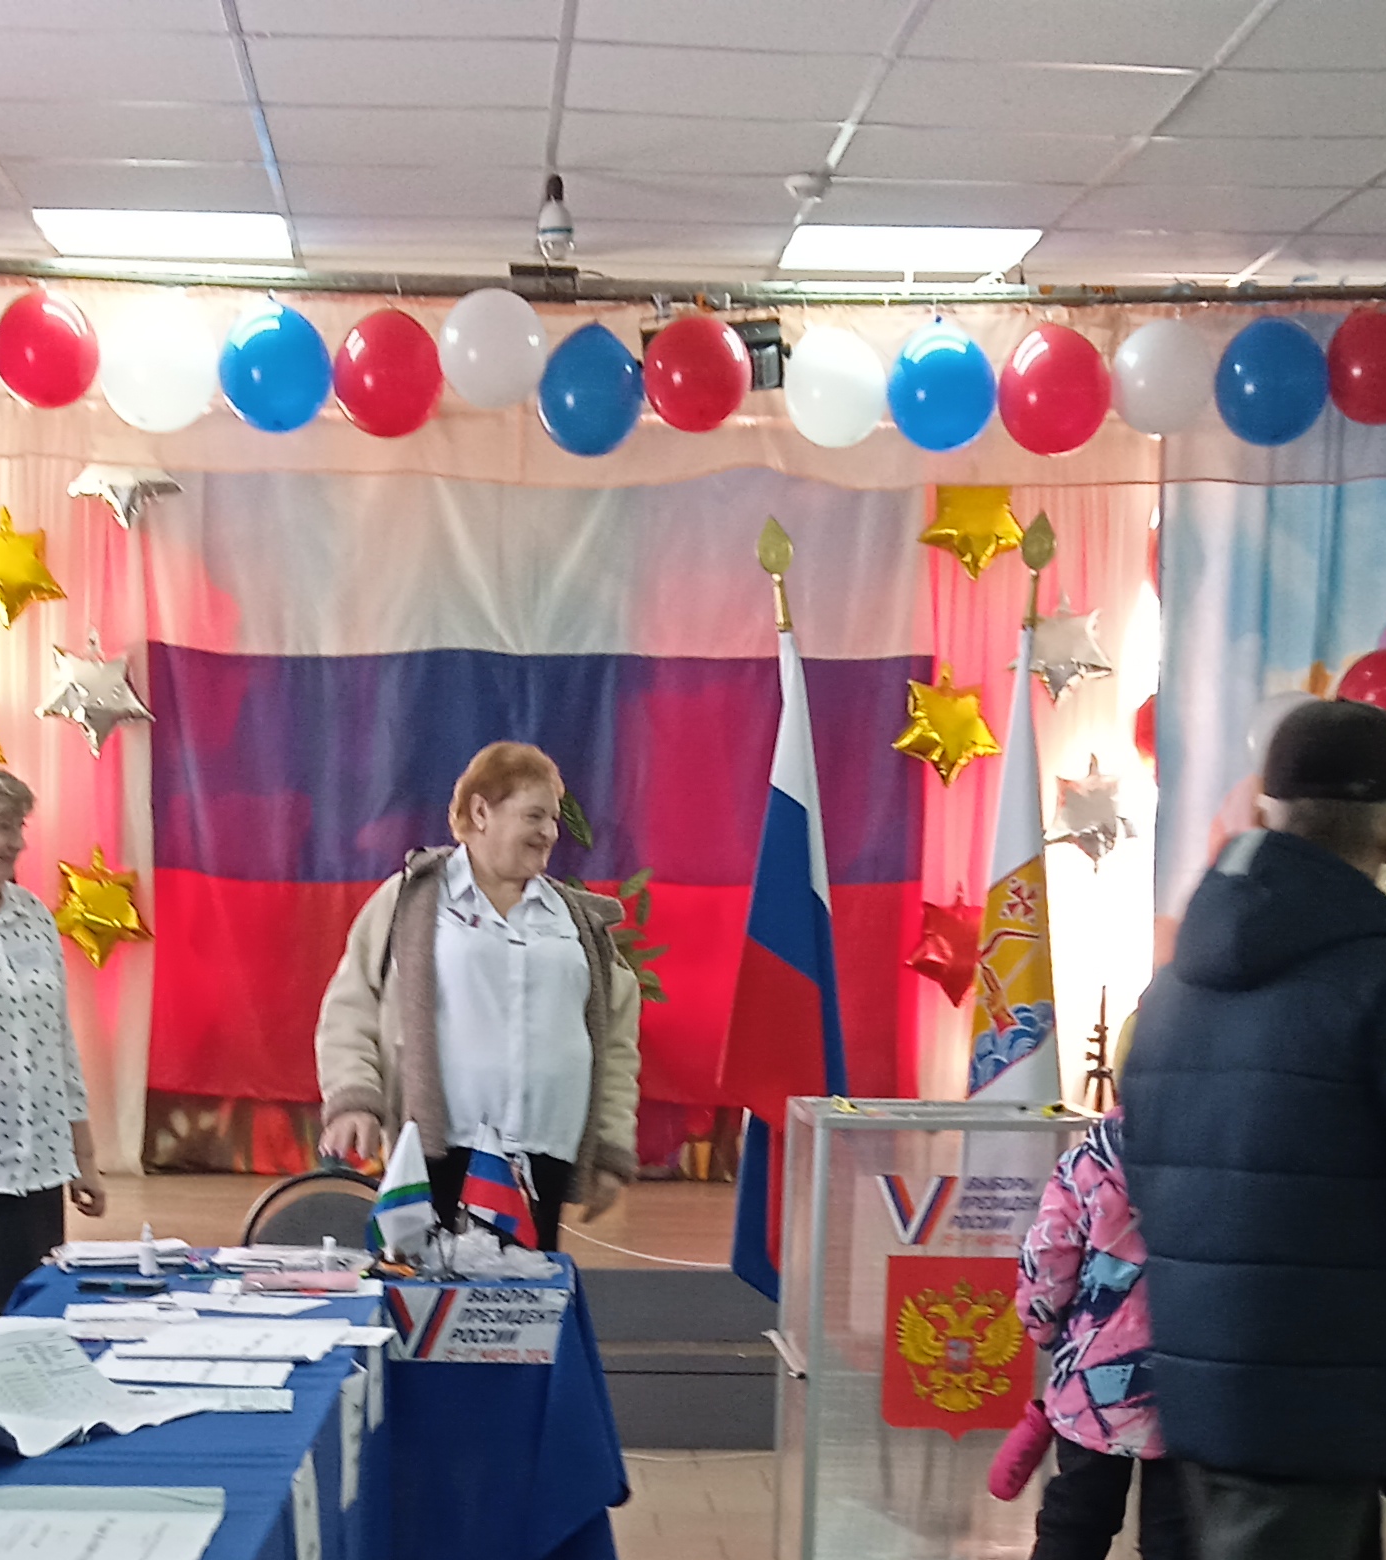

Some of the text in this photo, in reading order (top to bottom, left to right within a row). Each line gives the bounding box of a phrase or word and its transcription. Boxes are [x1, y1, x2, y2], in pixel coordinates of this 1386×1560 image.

[964, 1176, 1037, 1191] ВЫБОРЫ
[960, 1196, 1041, 1211] ПРЕЗИДЕН
[949, 1215, 1013, 1230] РОССИИ
[467, 1287, 544, 1304] ВЫБОРЫ
[458, 1308, 562, 1324] ПРЕЗИДЕНТ
[449, 1328, 521, 1344] РОССИИ
